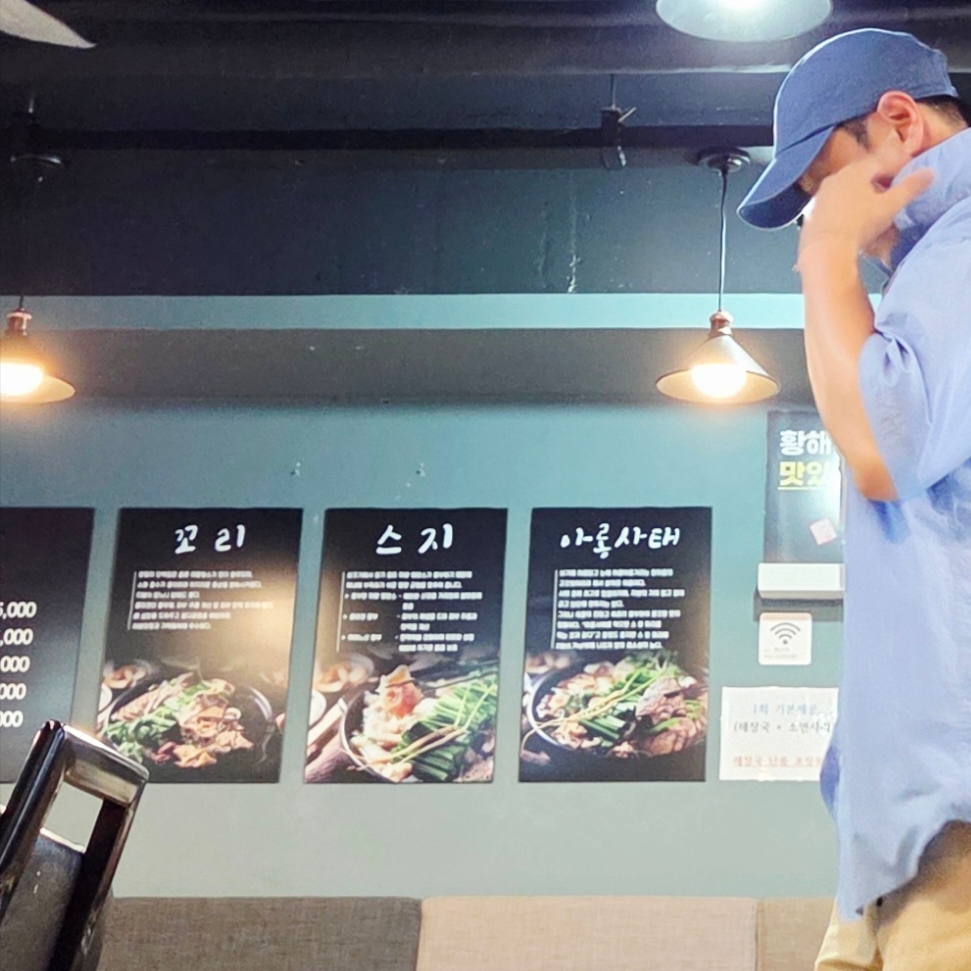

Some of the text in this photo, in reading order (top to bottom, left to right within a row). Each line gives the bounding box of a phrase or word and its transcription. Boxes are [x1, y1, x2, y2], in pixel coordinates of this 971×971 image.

[174, 524, 246, 555] 꼬리
[376, 523, 453, 555] 스지
[560, 523, 680, 559] 아롱사태
